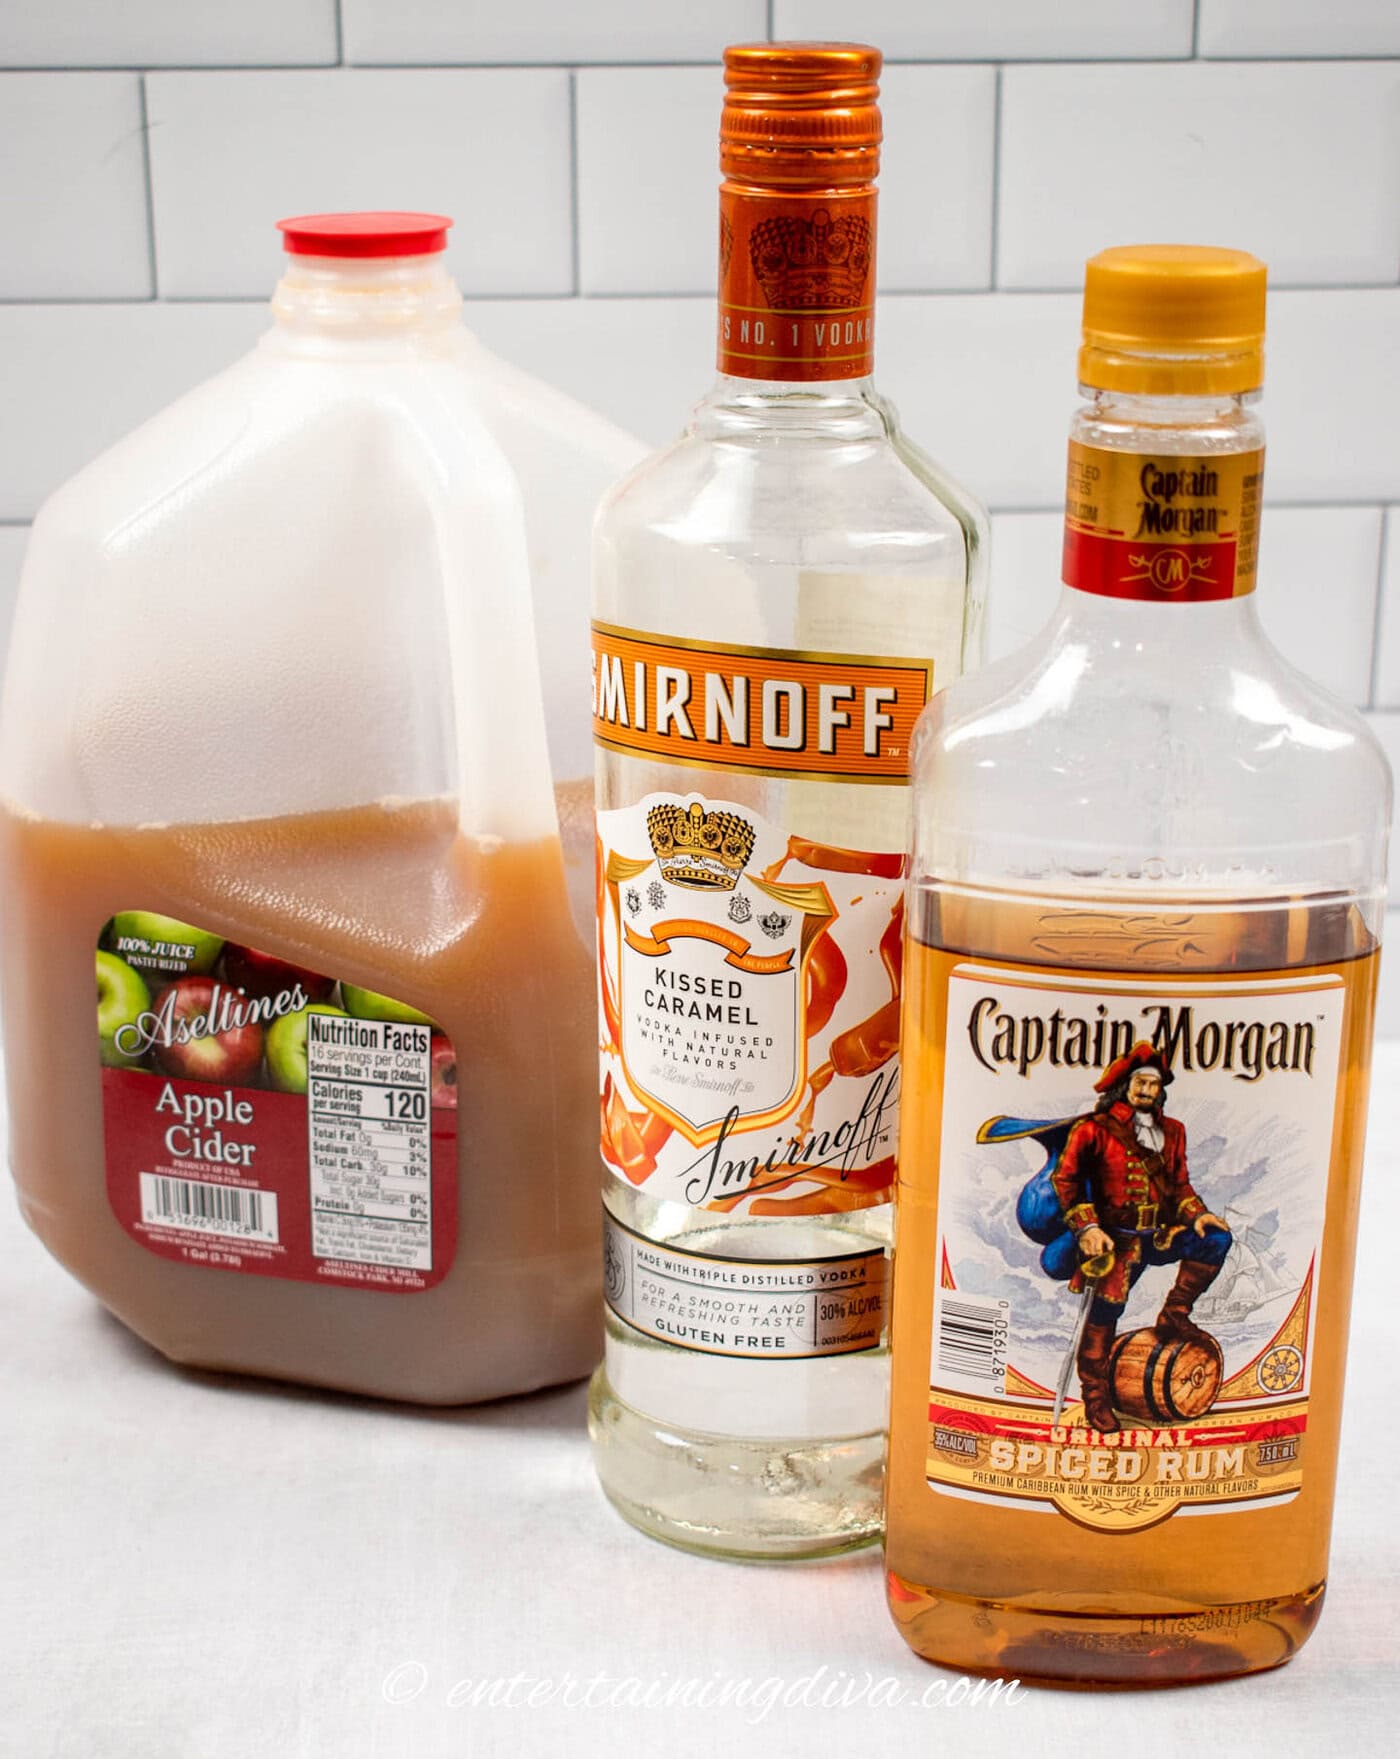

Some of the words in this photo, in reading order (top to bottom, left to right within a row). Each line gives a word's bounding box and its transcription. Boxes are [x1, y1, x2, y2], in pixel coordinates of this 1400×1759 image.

[741, 319, 775, 346] NO.
[792, 324, 798, 347] 1
[1140, 462, 1219, 502] Captain
[1134, 501, 1220, 539] Morgan
[117, 937, 151, 953] 100%
[151, 940, 195, 959] JUICE
[656, 967, 742, 999] KISSED
[114, 983, 309, 1057] Aseltines
[644, 989, 759, 1026] CARAMEL
[311, 1016, 378, 1049] Nutrition
[383, 1025, 428, 1053] Facts
[637, 1013, 682, 1036] VODKA
[693, 1031, 773, 1047] INFUSED
[640, 1028, 675, 1046] WITH
[686, 1042, 768, 1060] NATURAL
[967, 996, 1135, 1079] Captain
[1141, 1006, 1315, 1083] Morgan
[311, 1060, 342, 1076] Serving
[344, 1063, 362, 1077] Size
[365, 1067, 369, 1077] 1
[373, 1069, 388, 1081] cup
[312, 1045, 325, 1059] 16
[327, 1048, 373, 1066] servings
[375, 1055, 392, 1068] per
[663, 1049, 737, 1071] FLAVORS
[155, 1082, 254, 1127] Apple
[312, 1082, 363, 1101] Calories
[384, 1090, 426, 1120] 120
[313, 1100, 327, 1110] per
[330, 1101, 361, 1115] serving
[165, 1124, 257, 1166] Cider
[313, 1127, 337, 1139] Total
[340, 1129, 356, 1141] Fat
[409, 1137, 427, 1148] 0%
[675, 1066, 899, 1205] Smirnoff
[313, 1141, 348, 1154] Sodium
[409, 1152, 427, 1162] 3%
[313, 1155, 337, 1167] Total
[403, 1165, 427, 1177] 10%
[314, 1196, 350, 1210] Protein
[410, 1208, 427, 1219] 0%
[410, 1194, 427, 1205] 0%
[191, 1250, 208, 1261] Gal
[637, 1250, 660, 1267] MADE
[664, 1260, 689, 1275] WITH
[693, 1268, 737, 1283] TRIPLE
[742, 1275, 814, 1285] DISTILLED
[820, 1268, 866, 1284] VODKA
[640, 1280, 666, 1297] FOR
[672, 1292, 680, 1301] A
[689, 1296, 758, 1314] SMOOTH
[768, 1303, 806, 1314] AND
[640, 1295, 740, 1326] REFRESHING
[751, 1316, 806, 1327] TASTE
[820, 1304, 846, 1321] 30%
[655, 1318, 725, 1345] GLUTEN
[735, 1335, 786, 1348] FREE
[1050, 1426, 1193, 1447] ORIGINAL
[989, 1439, 1143, 1483] SPICED
[1156, 1446, 1248, 1483] RUM
[1260, 1446, 1277, 1462] 750
[973, 1472, 1014, 1488] PREMIUM
[1017, 1478, 1066, 1495] CARIBBEAN
[1068, 1483, 1089, 1496] RUM
[1091, 1484, 1113, 1497] WITH
[1115, 1485, 1141, 1497] SPICE
[1143, 1486, 1151, 1497] &
[1153, 1484, 1181, 1497] OTHER
[1183, 1482, 1221, 1496] NATURAL
[1223, 1479, 1259, 1494] FLAVORS
